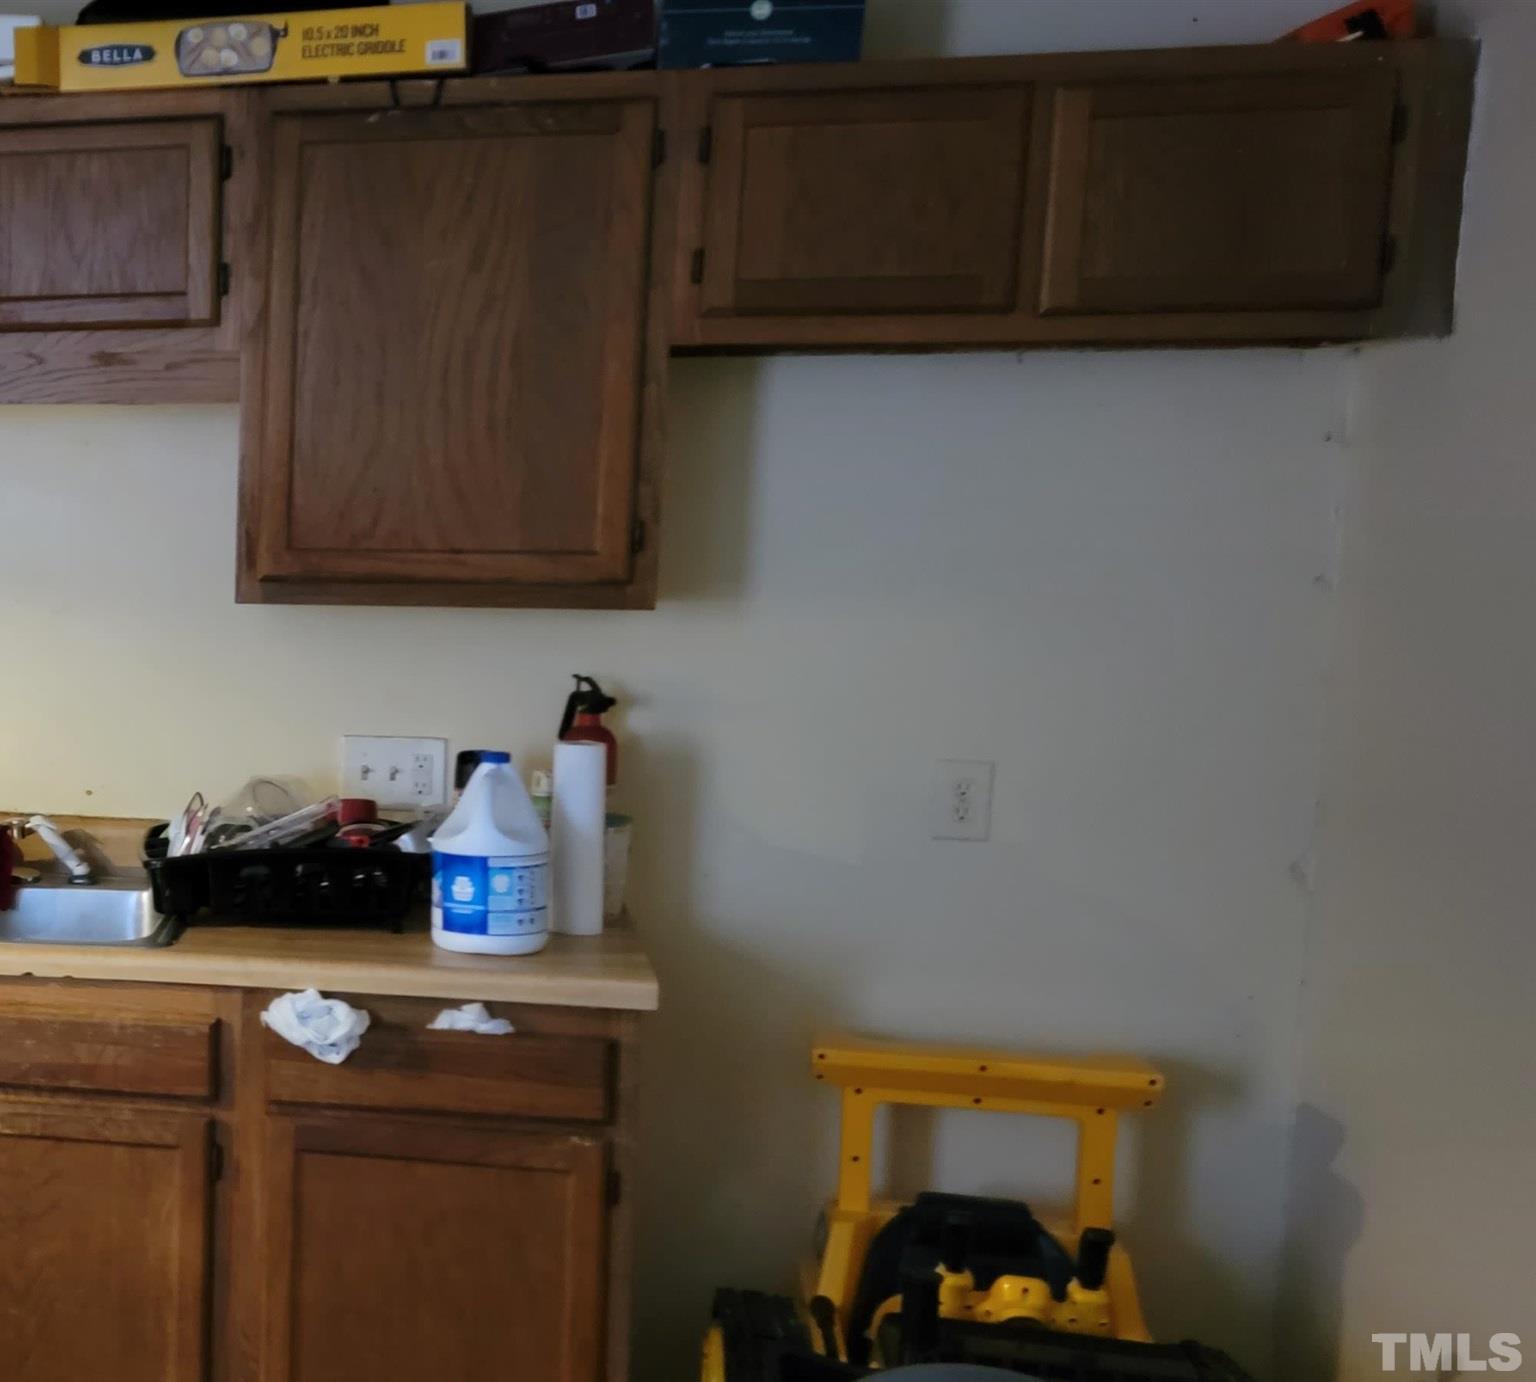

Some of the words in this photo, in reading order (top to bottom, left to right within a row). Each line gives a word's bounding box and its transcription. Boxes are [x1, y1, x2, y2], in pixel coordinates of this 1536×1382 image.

[351, 24, 379, 38] INCH
[91, 48, 143, 63] BELLA
[302, 43, 354, 58] ELECTRIC
[357, 39, 406, 55] GRIDDLE
